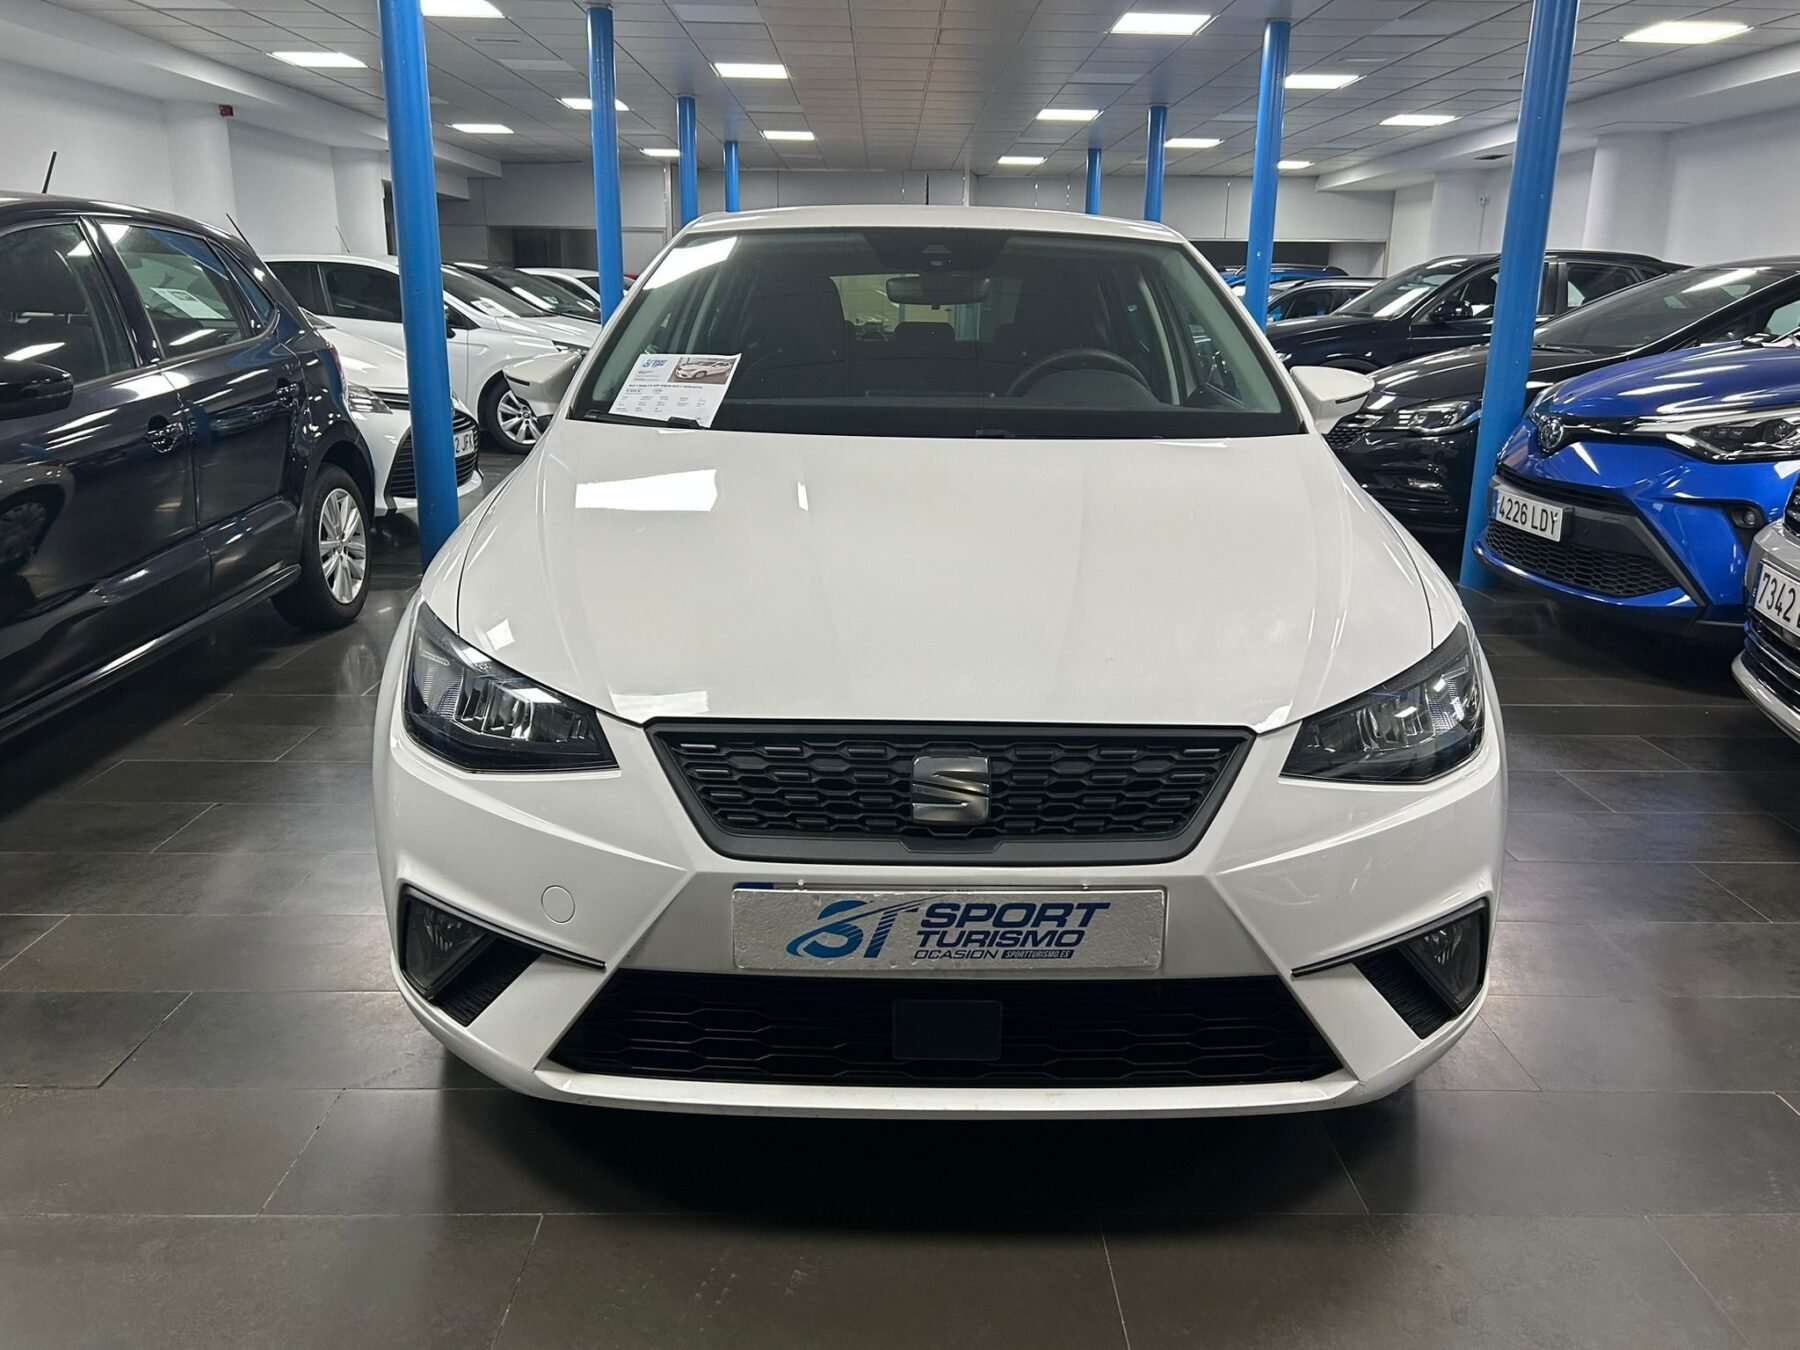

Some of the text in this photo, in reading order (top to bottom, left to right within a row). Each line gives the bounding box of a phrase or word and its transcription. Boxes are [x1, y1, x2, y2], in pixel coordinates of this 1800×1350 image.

[1499, 496, 1558, 535] 4226 LDY
[1758, 572, 1796, 622] 7342
[920, 902, 1109, 928] SPORT
[916, 930, 1085, 948] TURISMO
[913, 949, 1070, 959] OCASION SPORTTURISMO.ES
